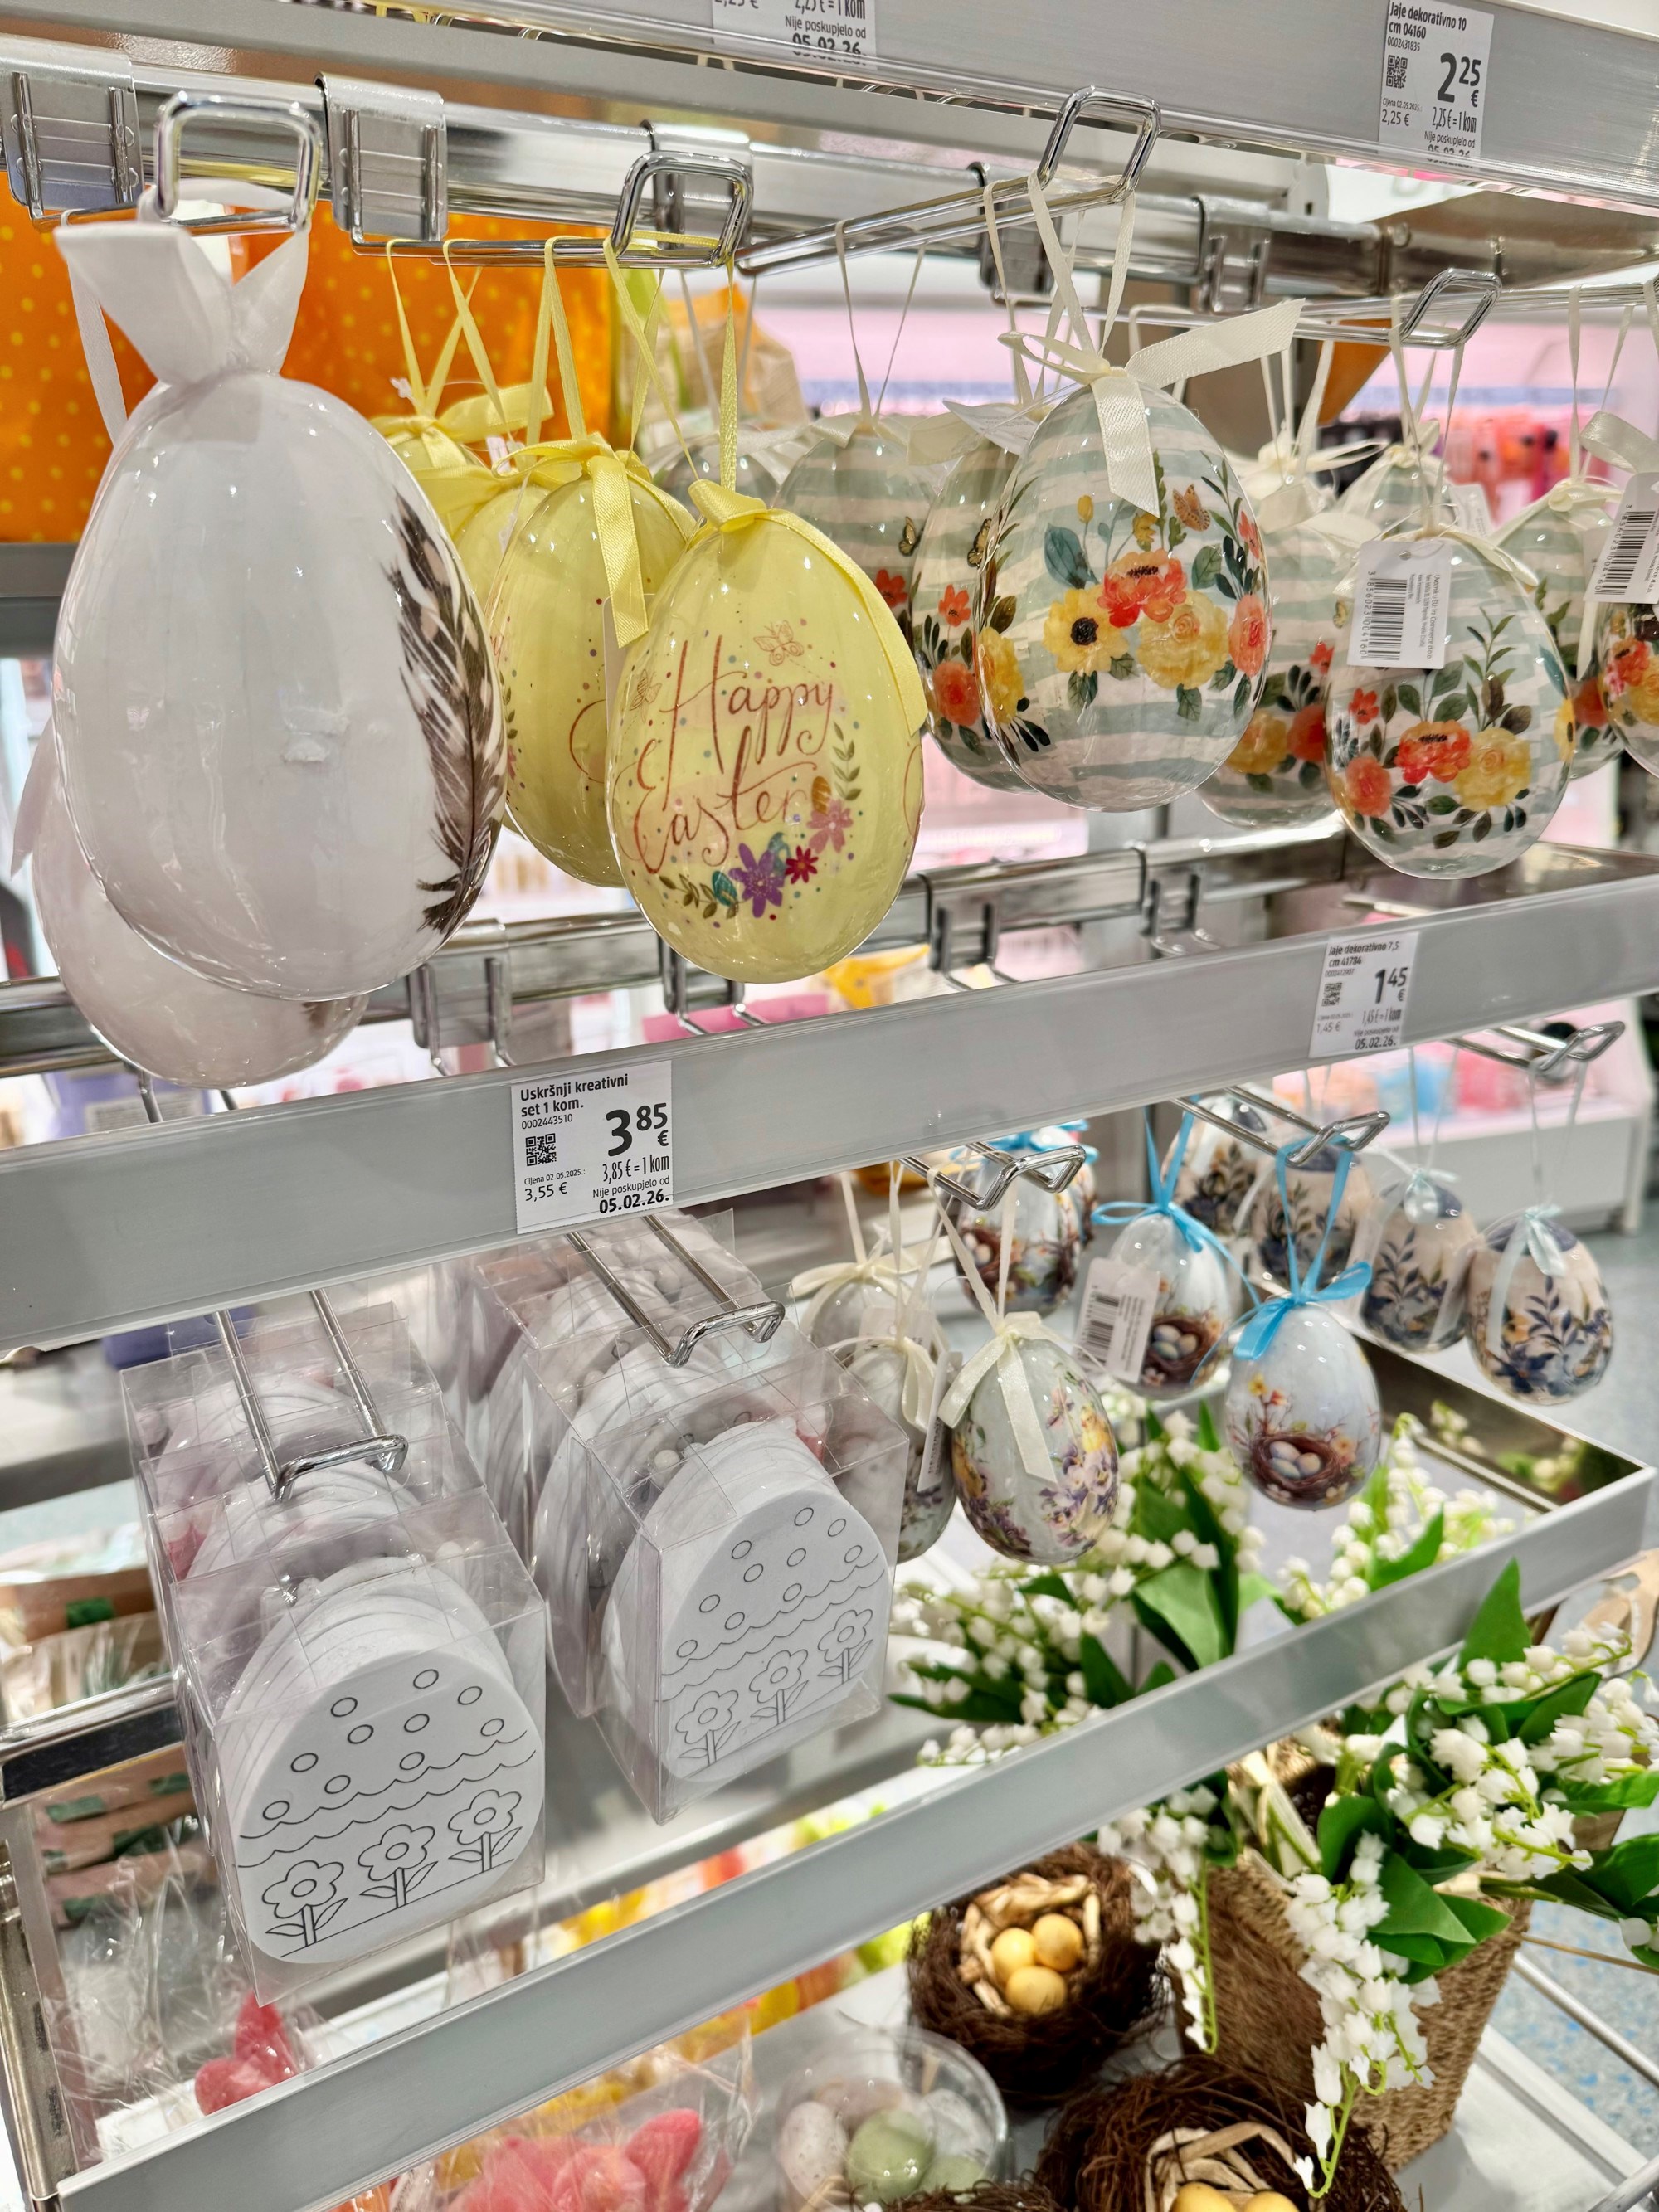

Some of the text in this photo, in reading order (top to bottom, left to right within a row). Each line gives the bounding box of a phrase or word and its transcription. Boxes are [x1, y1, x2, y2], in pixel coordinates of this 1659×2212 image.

[844, 0, 866, 20] kom
[1389, 2, 1467, 31] Jaje dekorativno 10
[785, 15, 866, 39] Nije poskupjelo od
[1389, 22, 1427, 39] cm 04160
[1387, 36, 1420, 52] 0002431835
[1470, 89, 1479, 108] €
[1381, 109, 1410, 127] 2,25 €
[1432, 106, 1447, 130] 2,25
[1447, 109, 1452, 129] €
[1462, 110, 1477, 134] kom
[1424, 130, 1475, 148] Nije poskupjelo od
[1428, 616, 1437, 644] Commerce
[659, 635, 833, 811] Happy
[612, 726, 818, 874] Easter
[1328, 941, 1399, 956] Jaje dekorativno 7,5
[1329, 956, 1362, 967] cm 41784
[1398, 988, 1406, 1002] €
[1389, 1006, 1402, 1022] kom
[1316, 1021, 1341, 1035] 1,45 €
[1355, 1035, 1396, 1050] 05.02.26.
[520, 1073, 629, 1101] Uskršnji kreativni
[521, 1098, 584, 1117] set 1 kom.
[521, 1113, 573, 1130] 0002443510
[657, 1130, 669, 1147] €
[602, 1160, 623, 1184] 3,85
[625, 1159, 632, 1178] €
[649, 1154, 669, 1173] kom
[523, 1174, 545, 1185] Cijena
[592, 1175, 670, 1198] Nije poskupjelo od
[524, 1181, 567, 1203] 3,55 €
[599, 1189, 669, 1214] 05.02.26.
